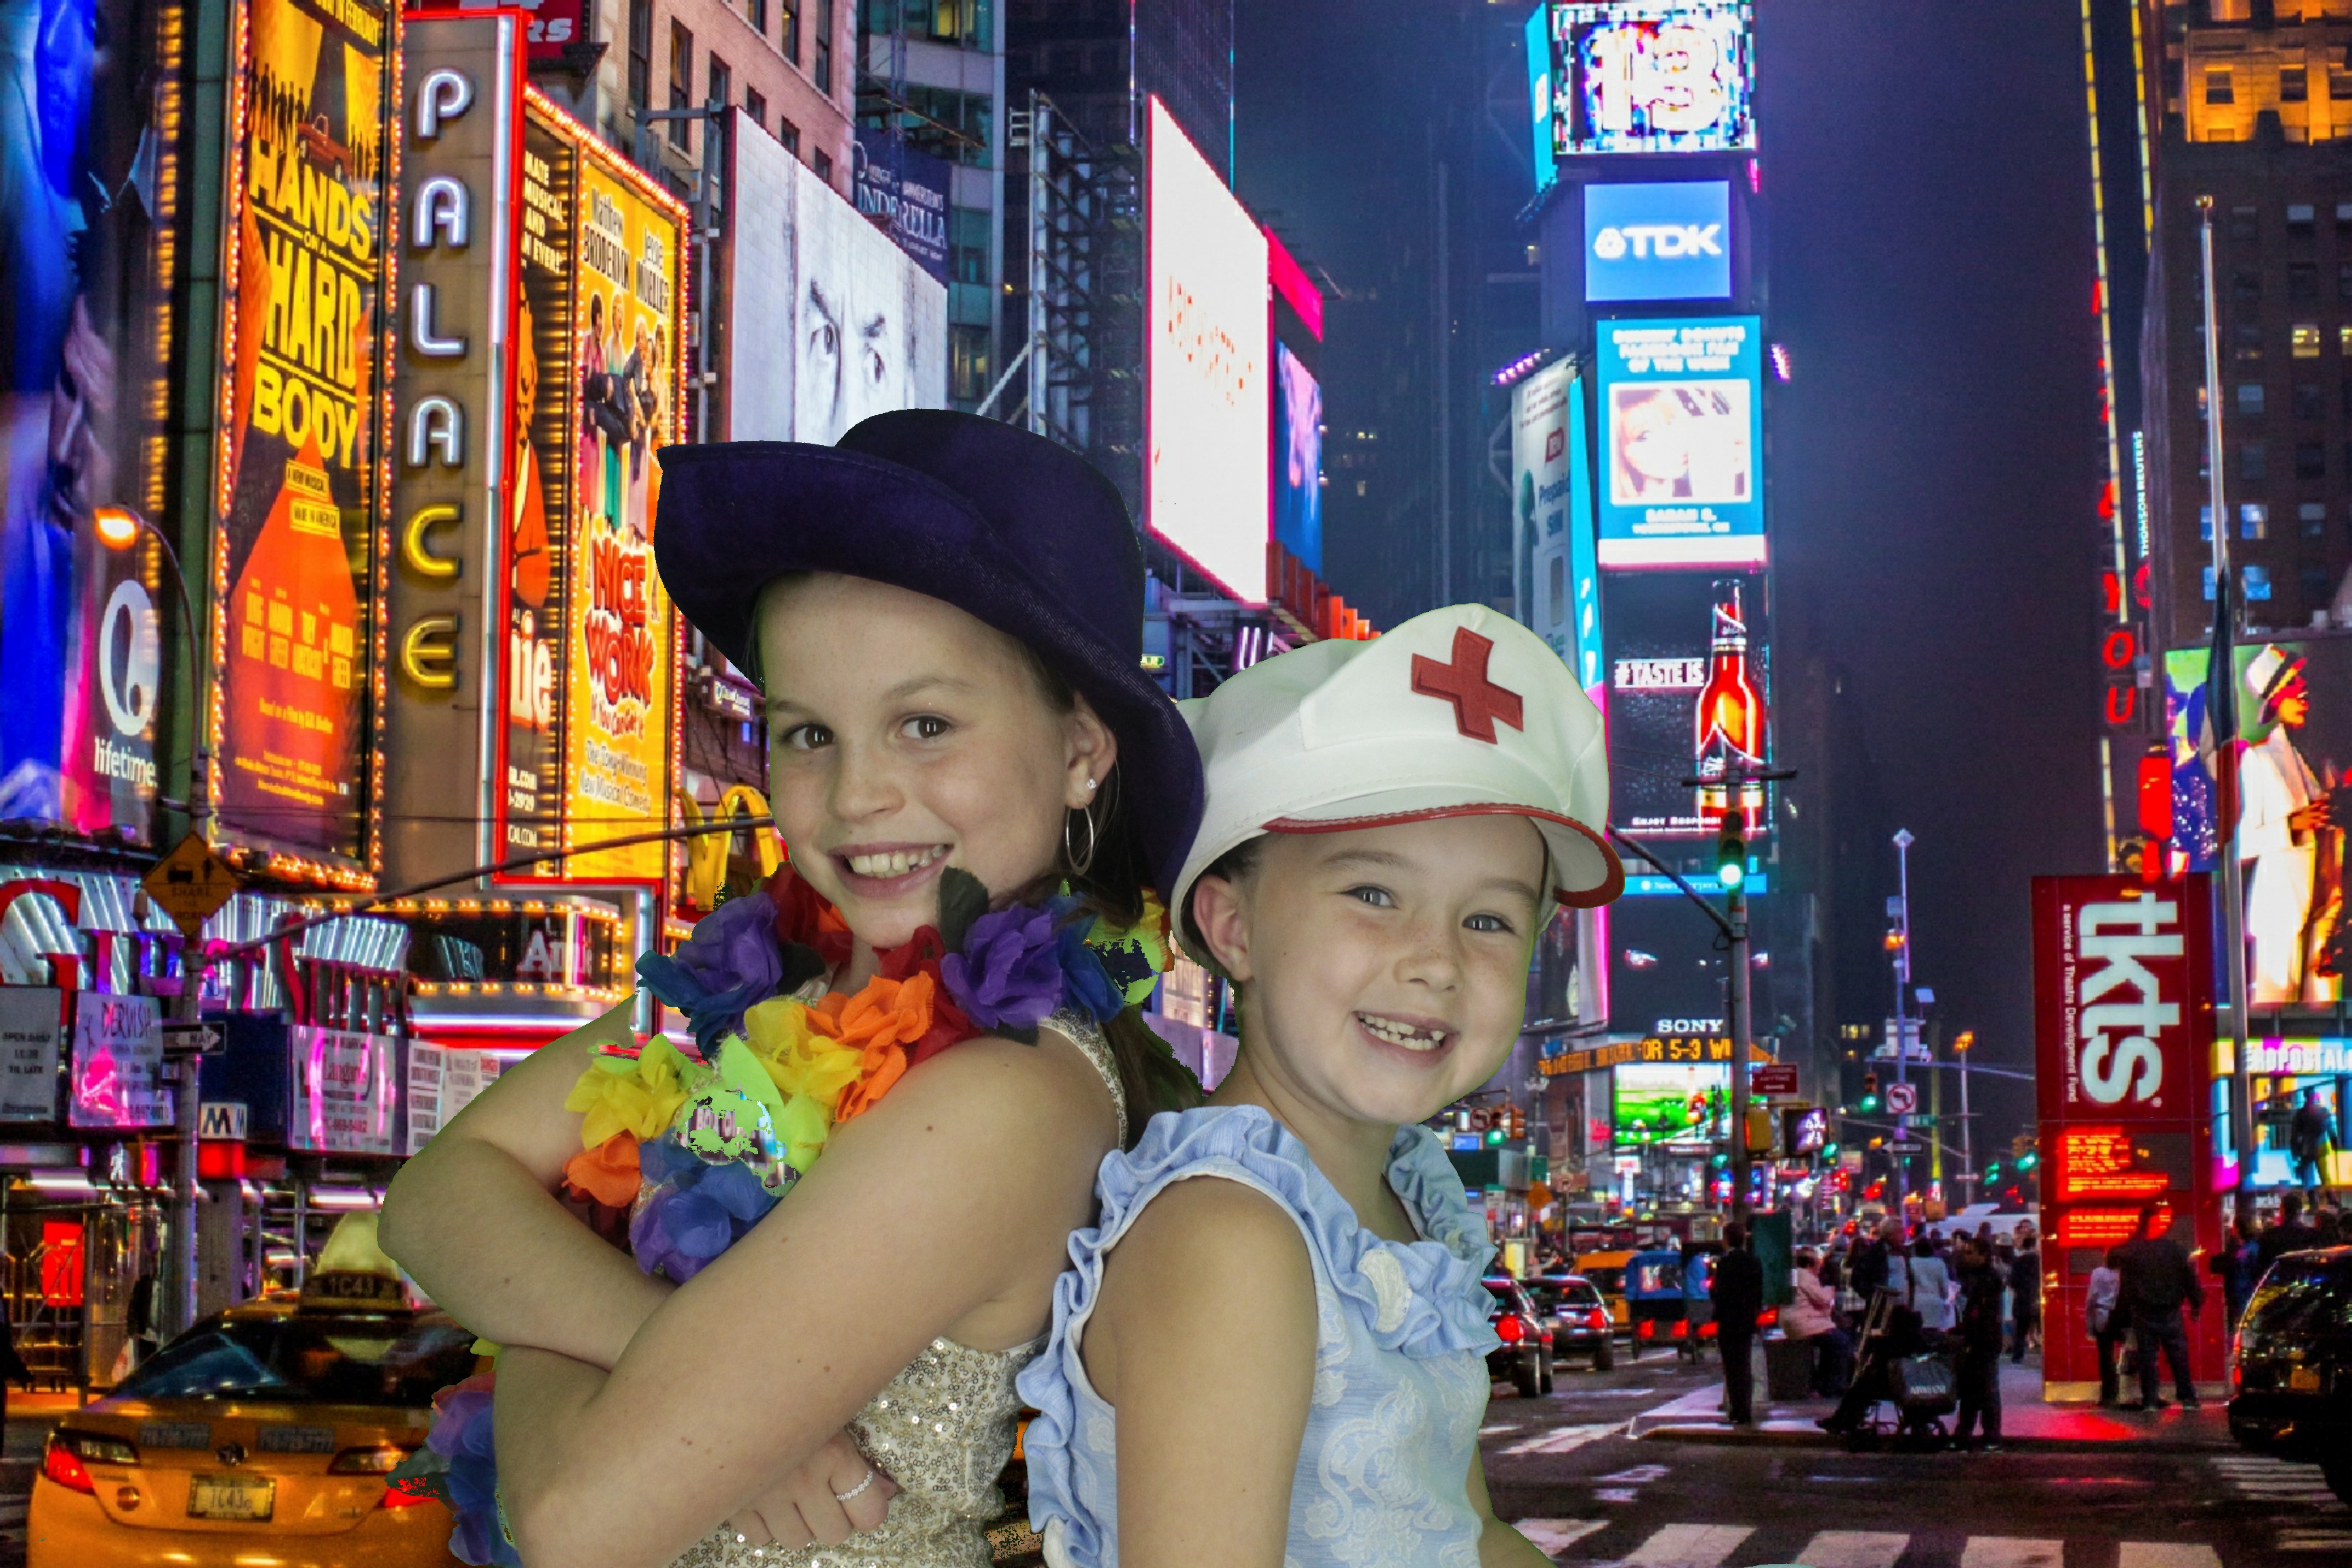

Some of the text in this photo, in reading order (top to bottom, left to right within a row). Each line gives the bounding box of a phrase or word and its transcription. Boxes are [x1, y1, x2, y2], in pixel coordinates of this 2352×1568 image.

[249, 138, 372, 261] HANDS
[304, 231, 327, 258] ON A
[1624, 224, 1722, 256] TDK
[267, 236, 361, 385] HARD
[252, 361, 358, 468] BODY
[402, 69, 474, 689] PALACE
[592, 537, 647, 627] NICE
[585, 614, 654, 706] WORK
[1658, 1019, 1724, 1032] SONY
[2079, 892, 2184, 1104] tkts
[1669, 1039, 1701, 1060] 5-3
